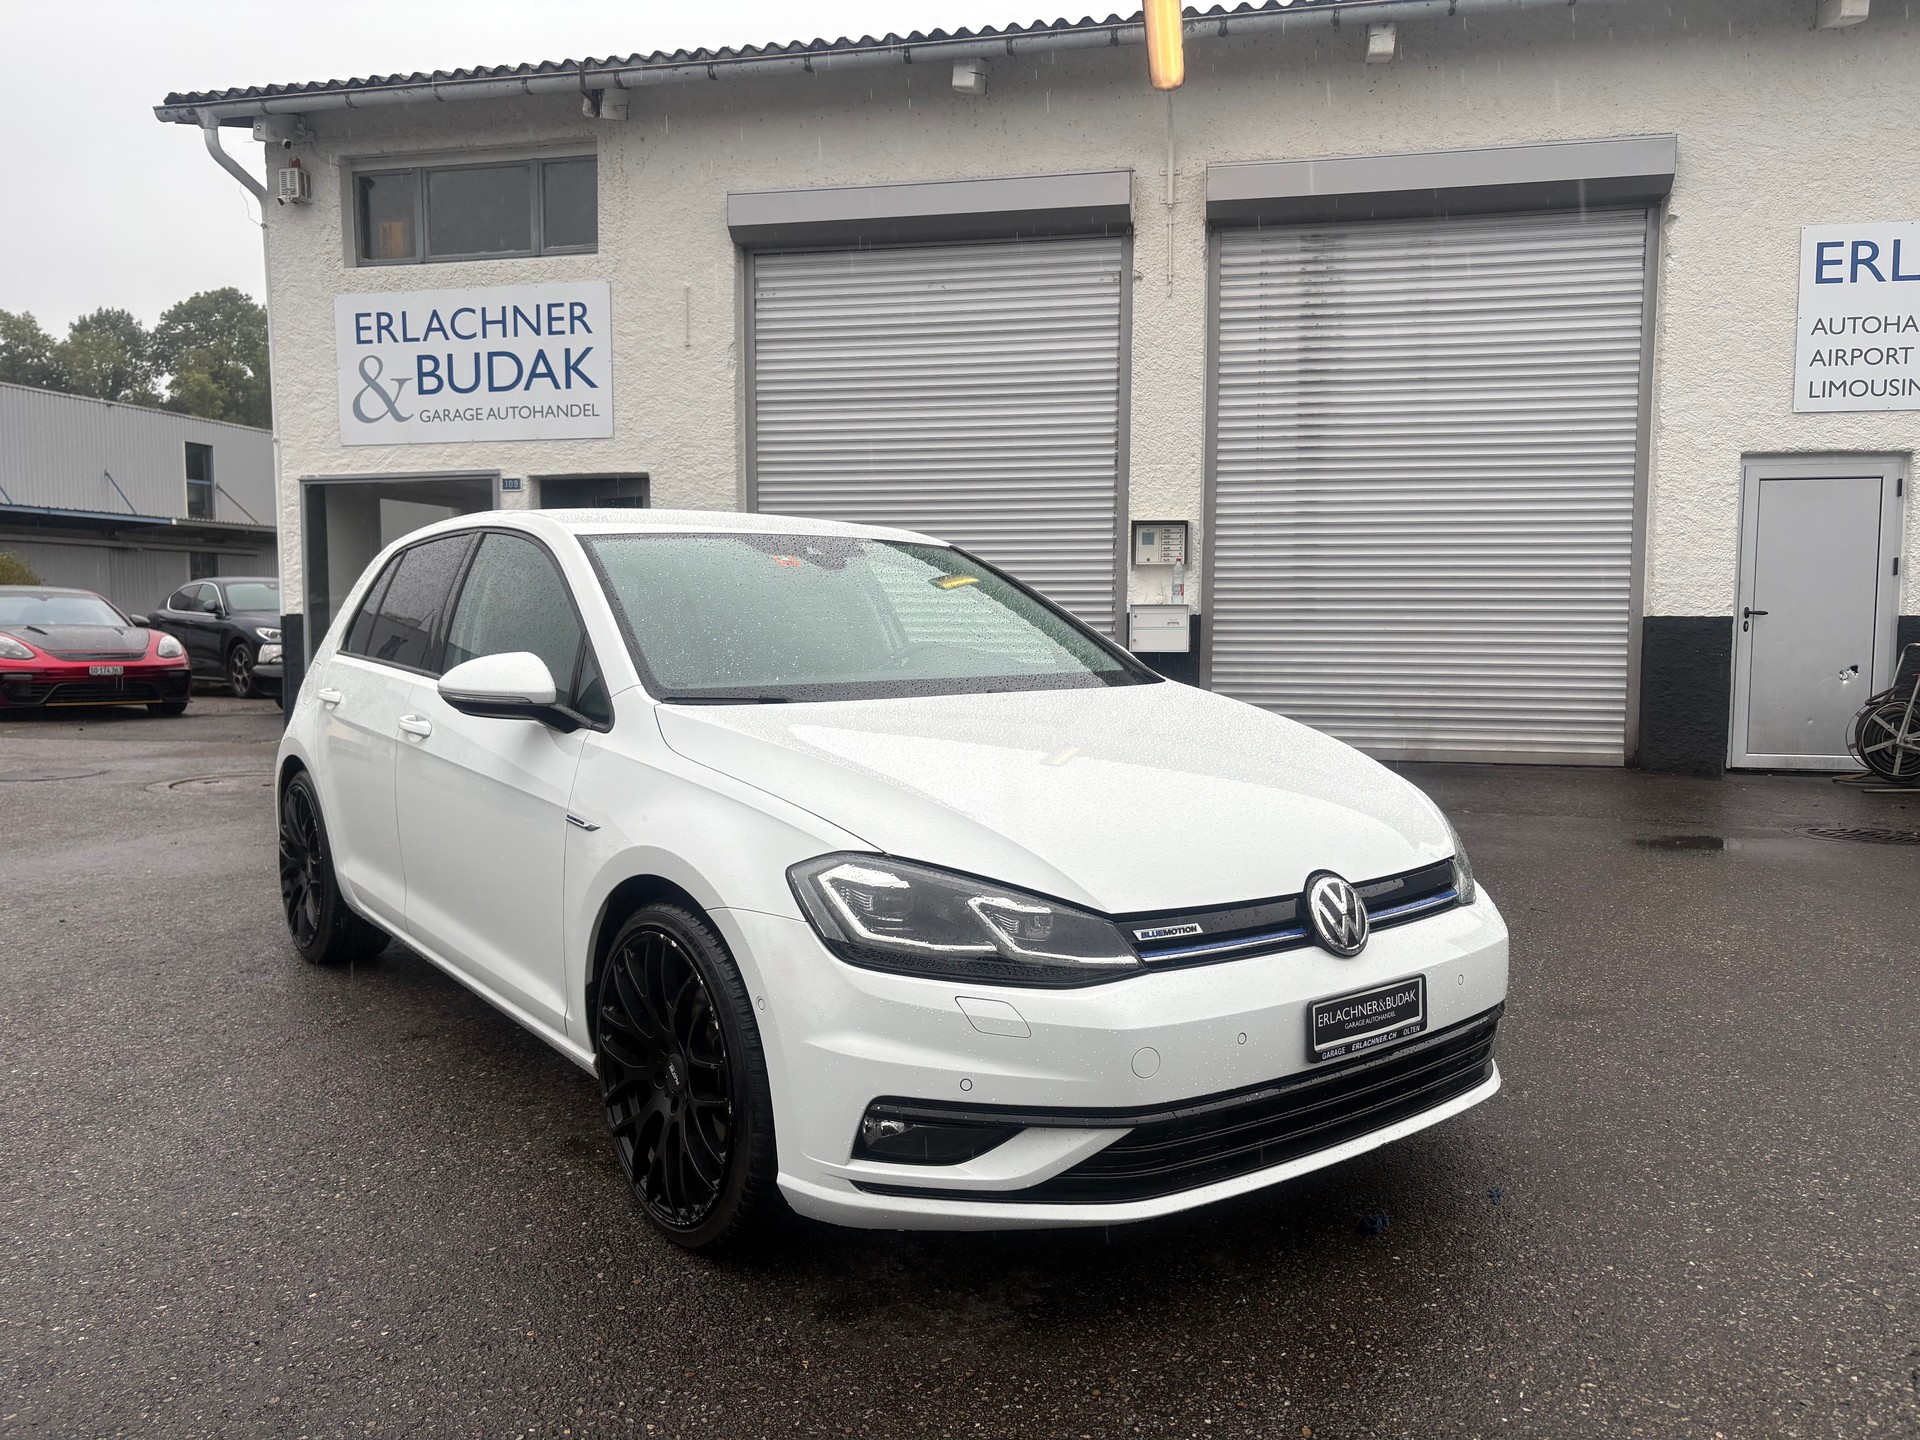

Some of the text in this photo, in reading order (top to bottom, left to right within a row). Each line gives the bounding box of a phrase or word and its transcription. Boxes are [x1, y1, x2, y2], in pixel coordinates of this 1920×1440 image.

[1815, 238, 1920, 284] ERL
[354, 301, 593, 345] ERLACHNER
[1810, 315, 1920, 336] AUTOHA
[1809, 346, 1915, 367] AIRPORT
[352, 346, 599, 423] & BUDAK
[419, 403, 600, 423] GARAGE AUTOHANDEL
[504, 479, 519, 488] 109
[1140, 925, 1197, 939] BLUEMOTION
[1344, 1010, 1396, 1030] GARAGE AUTOHANDEL
[1321, 1024, 1420, 1060] GARAGE ERLACHNER.CH OLTEN
